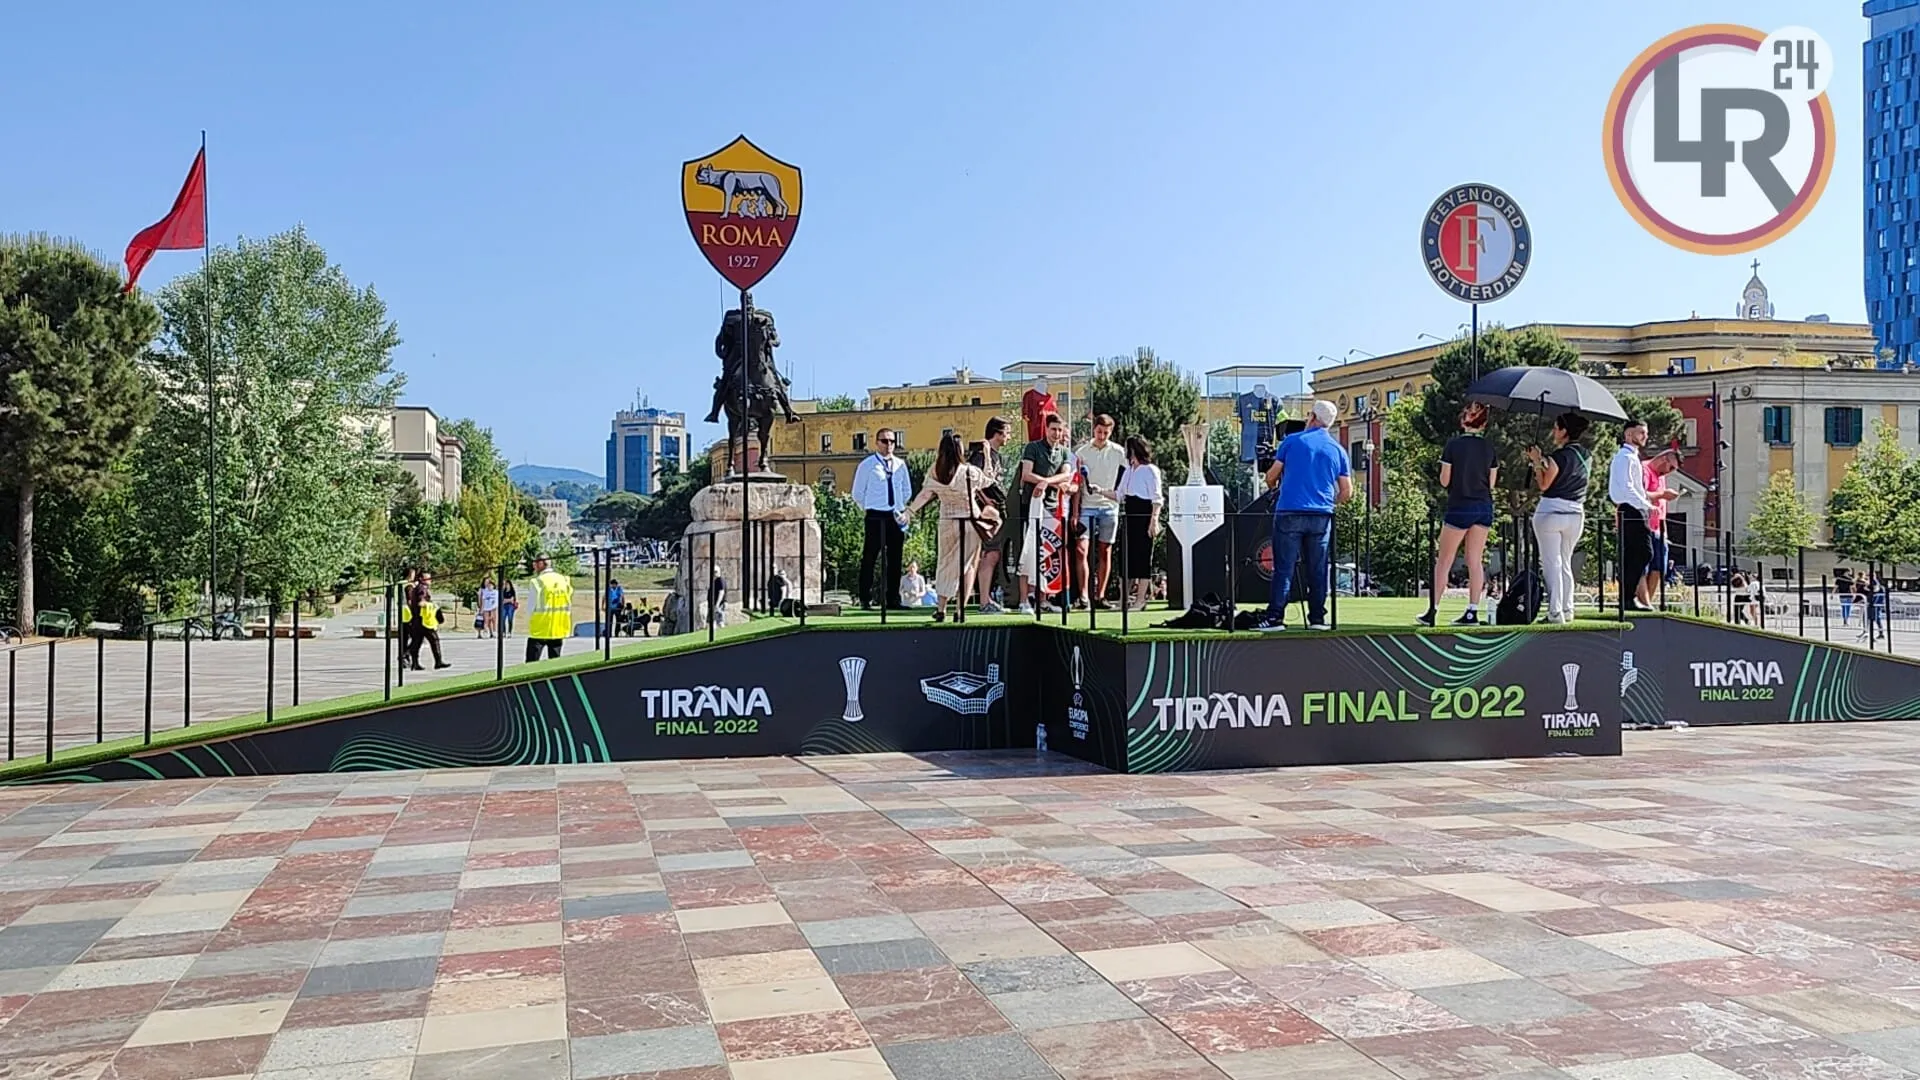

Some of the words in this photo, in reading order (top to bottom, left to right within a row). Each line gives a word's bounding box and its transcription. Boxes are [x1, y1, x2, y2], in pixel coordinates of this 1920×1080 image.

[1430, 187, 1523, 229] FEYENOORD
[702, 223, 785, 247] ROMA
[728, 255, 759, 268] 1927
[1429, 257, 1524, 299] ROTTERDAM
[1689, 659, 1784, 687] TIRANA
[640, 685, 773, 719] TIRANA
[1701, 689, 1740, 701] FINAL
[1742, 688, 1774, 700] 2022
[1152, 692, 1292, 731] TIRANA
[1303, 690, 1420, 725] FINAL
[1430, 685, 1526, 719] 2022
[655, 720, 710, 736] FINAL
[713, 719, 759, 734] 2022
[1541, 712, 1601, 729] TIRANA
[1547, 729, 1573, 737] FINAL
[1573, 728, 1595, 737] 2022
